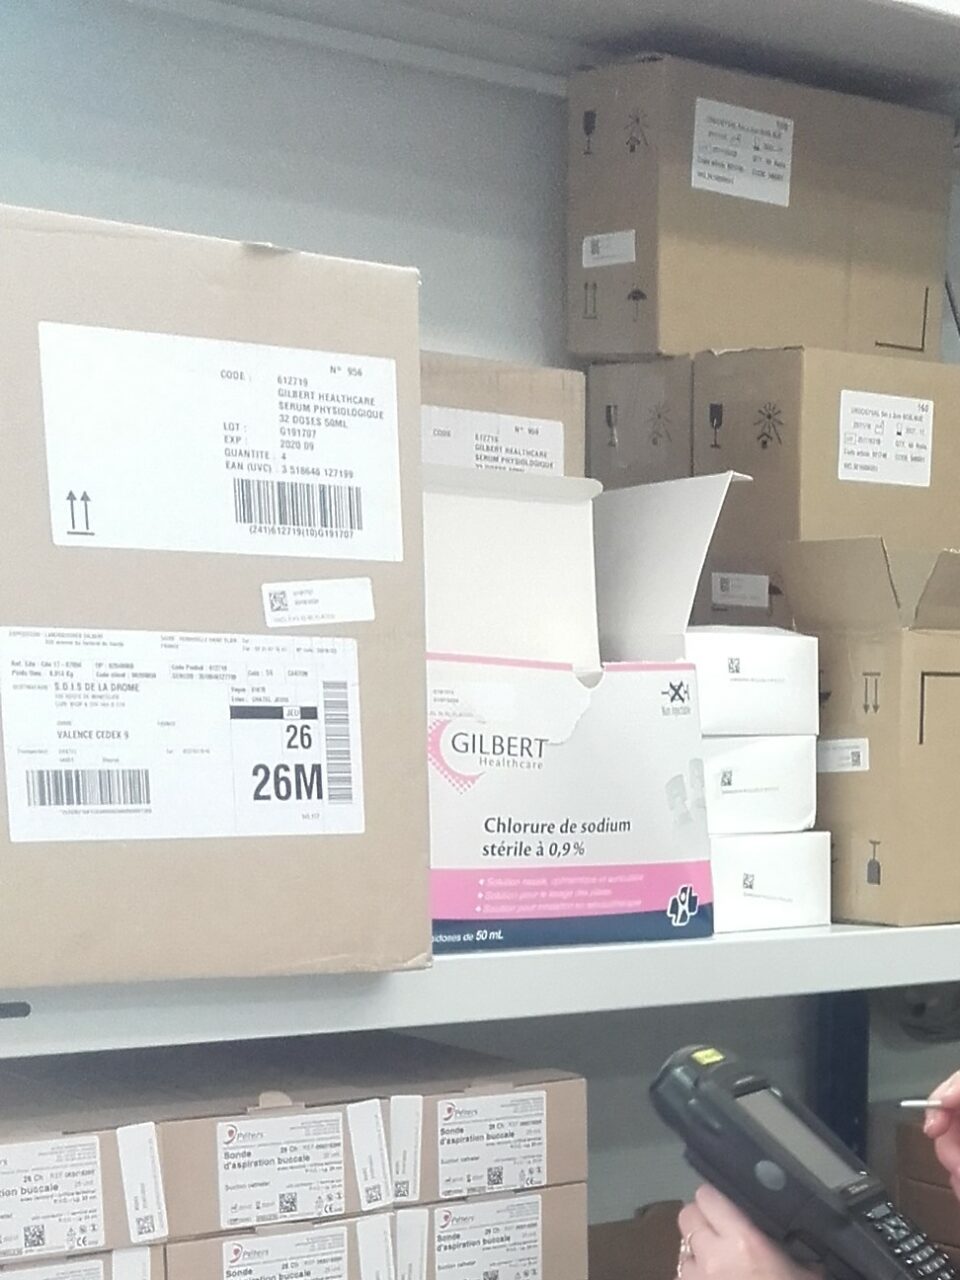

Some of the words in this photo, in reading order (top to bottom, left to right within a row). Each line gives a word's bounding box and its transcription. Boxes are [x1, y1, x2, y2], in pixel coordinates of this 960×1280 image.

[220, 369, 245, 381] CODE
[277, 375, 308, 387] 612719
[278, 388, 315, 400] GILBERT
[318, 392, 375, 406] HEALTHCARE
[278, 401, 311, 413] SERUM
[313, 404, 384, 420] PHYSIOLOGIQUE
[223, 421, 240, 432] LOT
[279, 413, 290, 424] 32
[292, 415, 322, 427] DOSES
[324, 418, 348, 429] 50ML
[280, 427, 317, 439] G191707
[224, 435, 242, 445] EXP
[280, 439, 301, 450] 2020
[224, 447, 270, 460] QUANTITE
[475, 443, 502, 453] GILBERT
[505, 447, 548, 459] HEALTHCARE
[226, 461, 244, 472] EAN
[247, 462, 273, 474] (UVC)
[475, 454, 499, 463] SERUM
[501, 457, 553, 469] PHYSIOLOGIQUE
[85, 682, 95, 692] DE
[98, 682, 108, 692] LA
[110, 682, 140, 693] DROME
[57, 730, 93, 739] VALENCE
[96, 730, 122, 739] CEDEX
[286, 724, 312, 749] 26
[451, 731, 549, 759] GILBERT
[479, 756, 543, 770] Healthcare
[252, 763, 323, 801] 26M
[484, 817, 556, 834] Chlorure
[560, 818, 577, 834] de
[580, 817, 631, 833] sodium
[482, 840, 532, 857] stérile
[536, 841, 544, 856] à
[463, 933, 474, 942] de
[476, 930, 488, 941] 50
[489, 929, 504, 940] mL
[440, 1127, 464, 1136] Sonde
[486, 1131, 515, 1140] buccale
[224, 1151, 252, 1159] Sonde
[224, 1159, 275, 1170] d'aspiration
[277, 1155, 310, 1164] buccale
[21, 1183, 59, 1195] buccale
[437, 1234, 460, 1242] Sonde
[483, 1236, 511, 1245] buccale
[226, 1268, 253, 1278] Sonde
[279, 1270, 311, 1280] buccale
